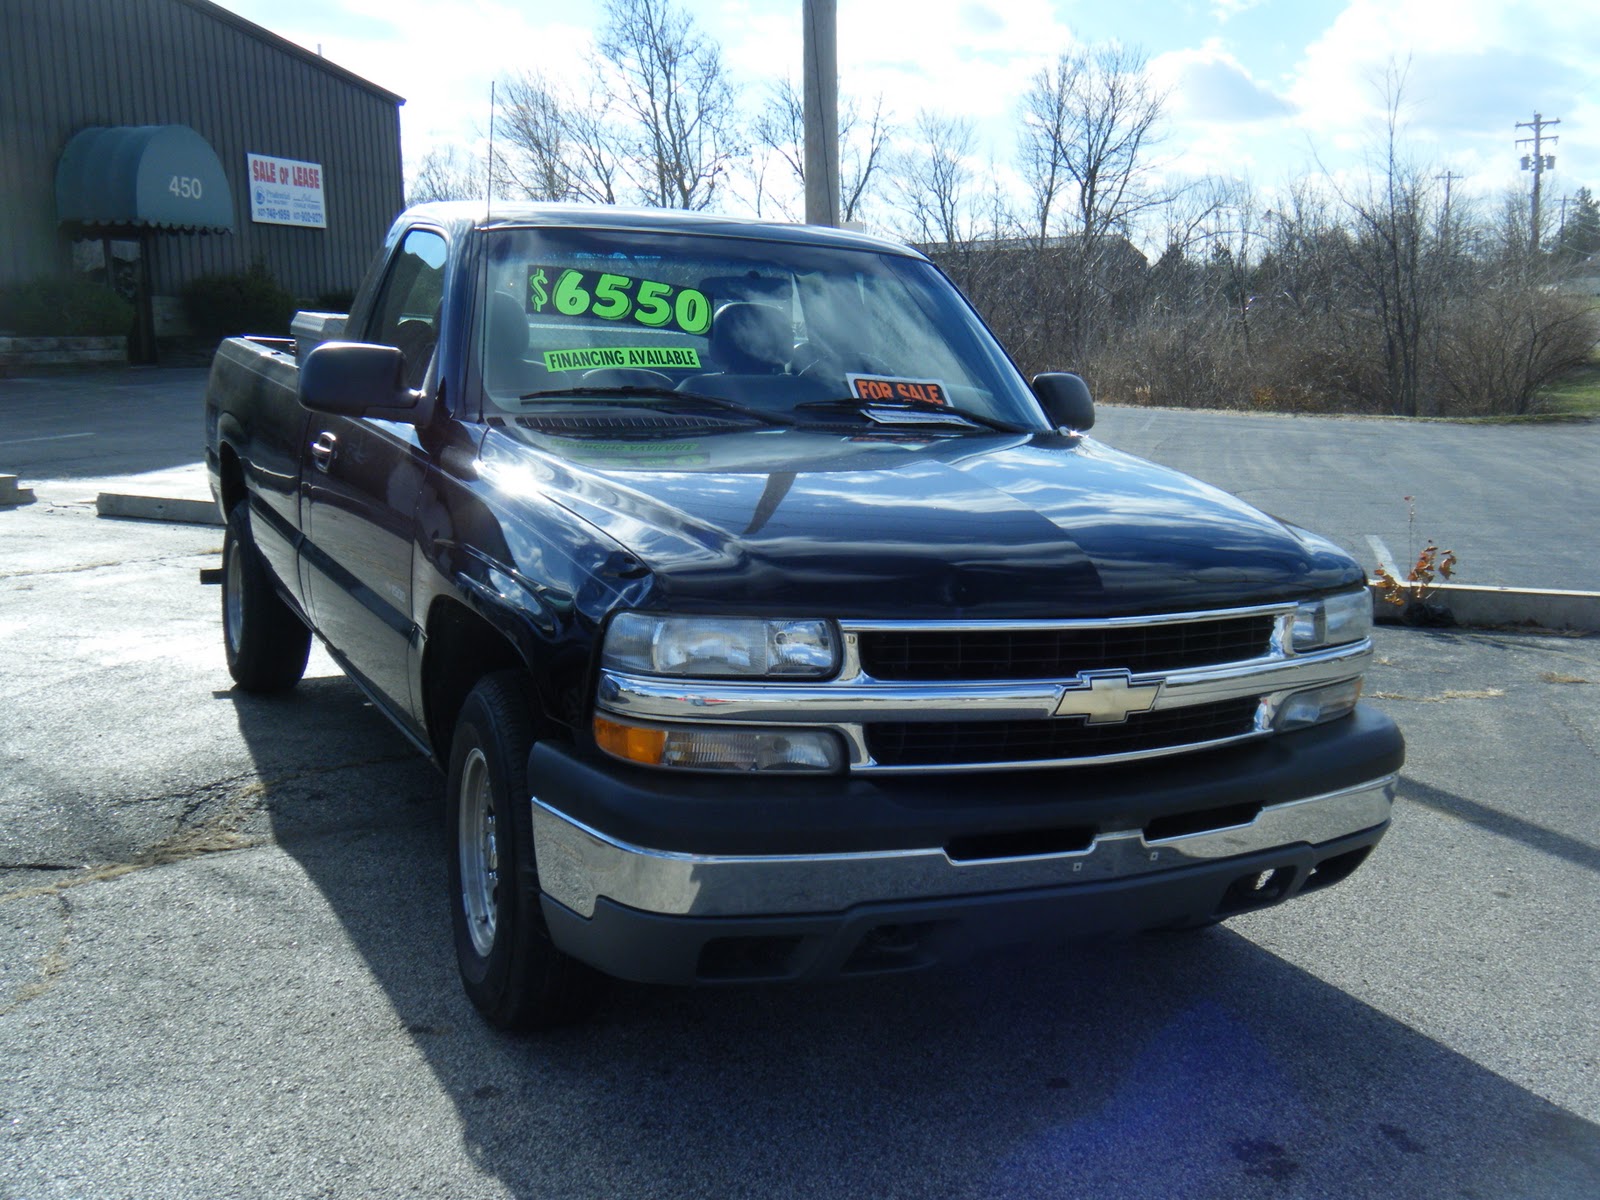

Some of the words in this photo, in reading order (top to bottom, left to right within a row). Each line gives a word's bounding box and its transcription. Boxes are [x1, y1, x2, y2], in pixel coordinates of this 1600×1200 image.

[252, 160, 276, 183] SALE
[292, 166, 320, 189] LEASE
[169, 175, 202, 200] 450
[530, 268, 712, 335] $6550
[549, 350, 625, 369] FINANCING
[629, 350, 696, 366] AVAILABLE
[857, 380, 894, 399] FOR
[896, 383, 944, 405] SALE
